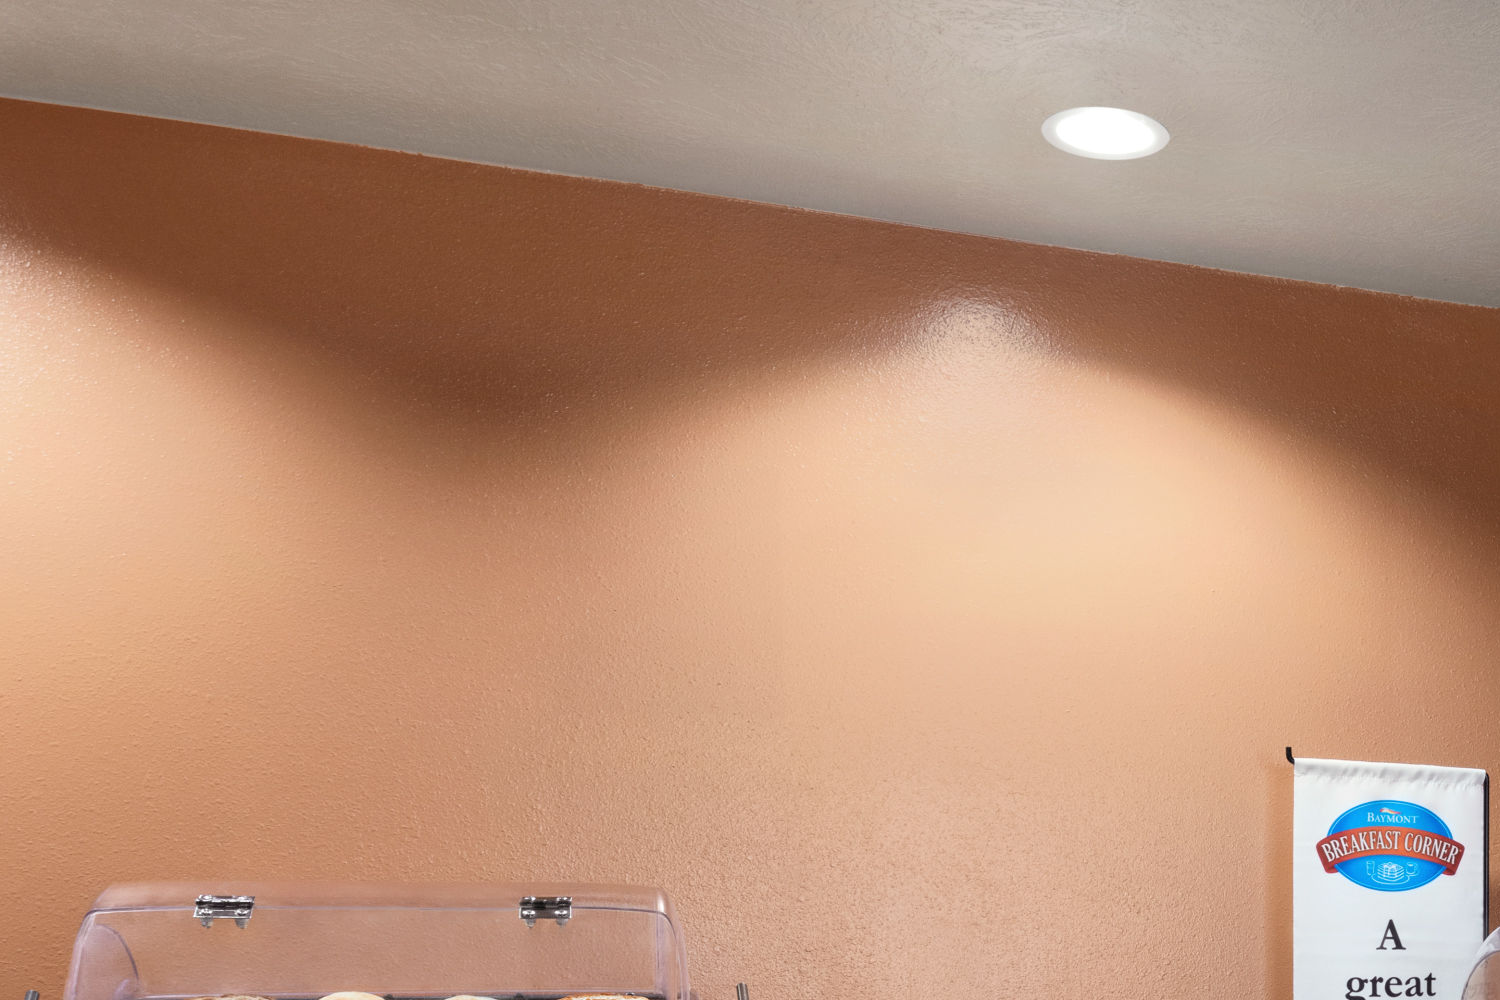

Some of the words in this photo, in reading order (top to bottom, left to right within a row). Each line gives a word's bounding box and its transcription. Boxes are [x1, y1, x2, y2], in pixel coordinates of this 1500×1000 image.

[1367, 811, 1417, 824] BAYMONT
[1321, 830, 1401, 863] BREAKFAST
[1404, 832, 1460, 865] CORNER
[1376, 918, 1406, 951] A
